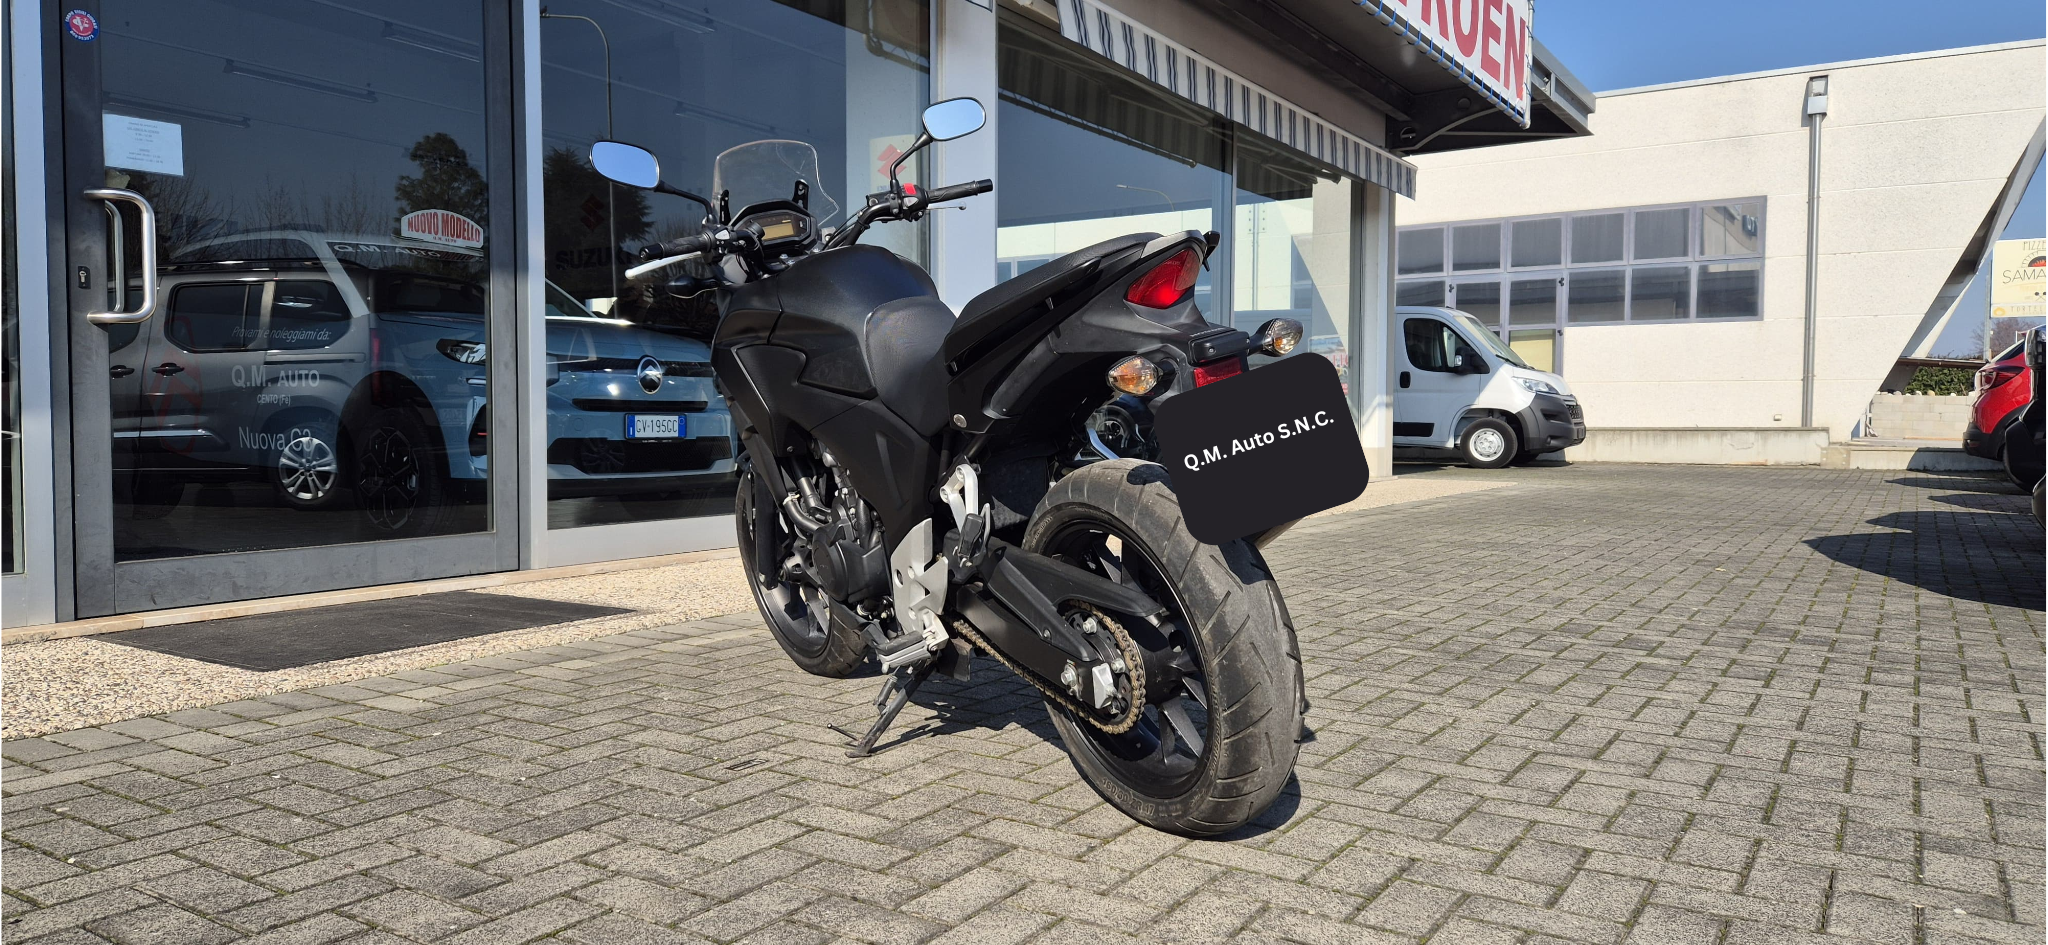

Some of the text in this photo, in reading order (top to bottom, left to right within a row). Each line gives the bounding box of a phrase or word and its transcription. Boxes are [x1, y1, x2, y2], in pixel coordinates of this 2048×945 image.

[407, 211, 481, 243] NUOVO MODELLO
[231, 326, 264, 338] Provami
[270, 327, 317, 343] noleggiami
[317, 328, 332, 341] da:
[231, 364, 320, 389] Q.M. AUTO
[257, 394, 291, 407] CENTO (Fe)
[238, 426, 286, 451] Nuova
